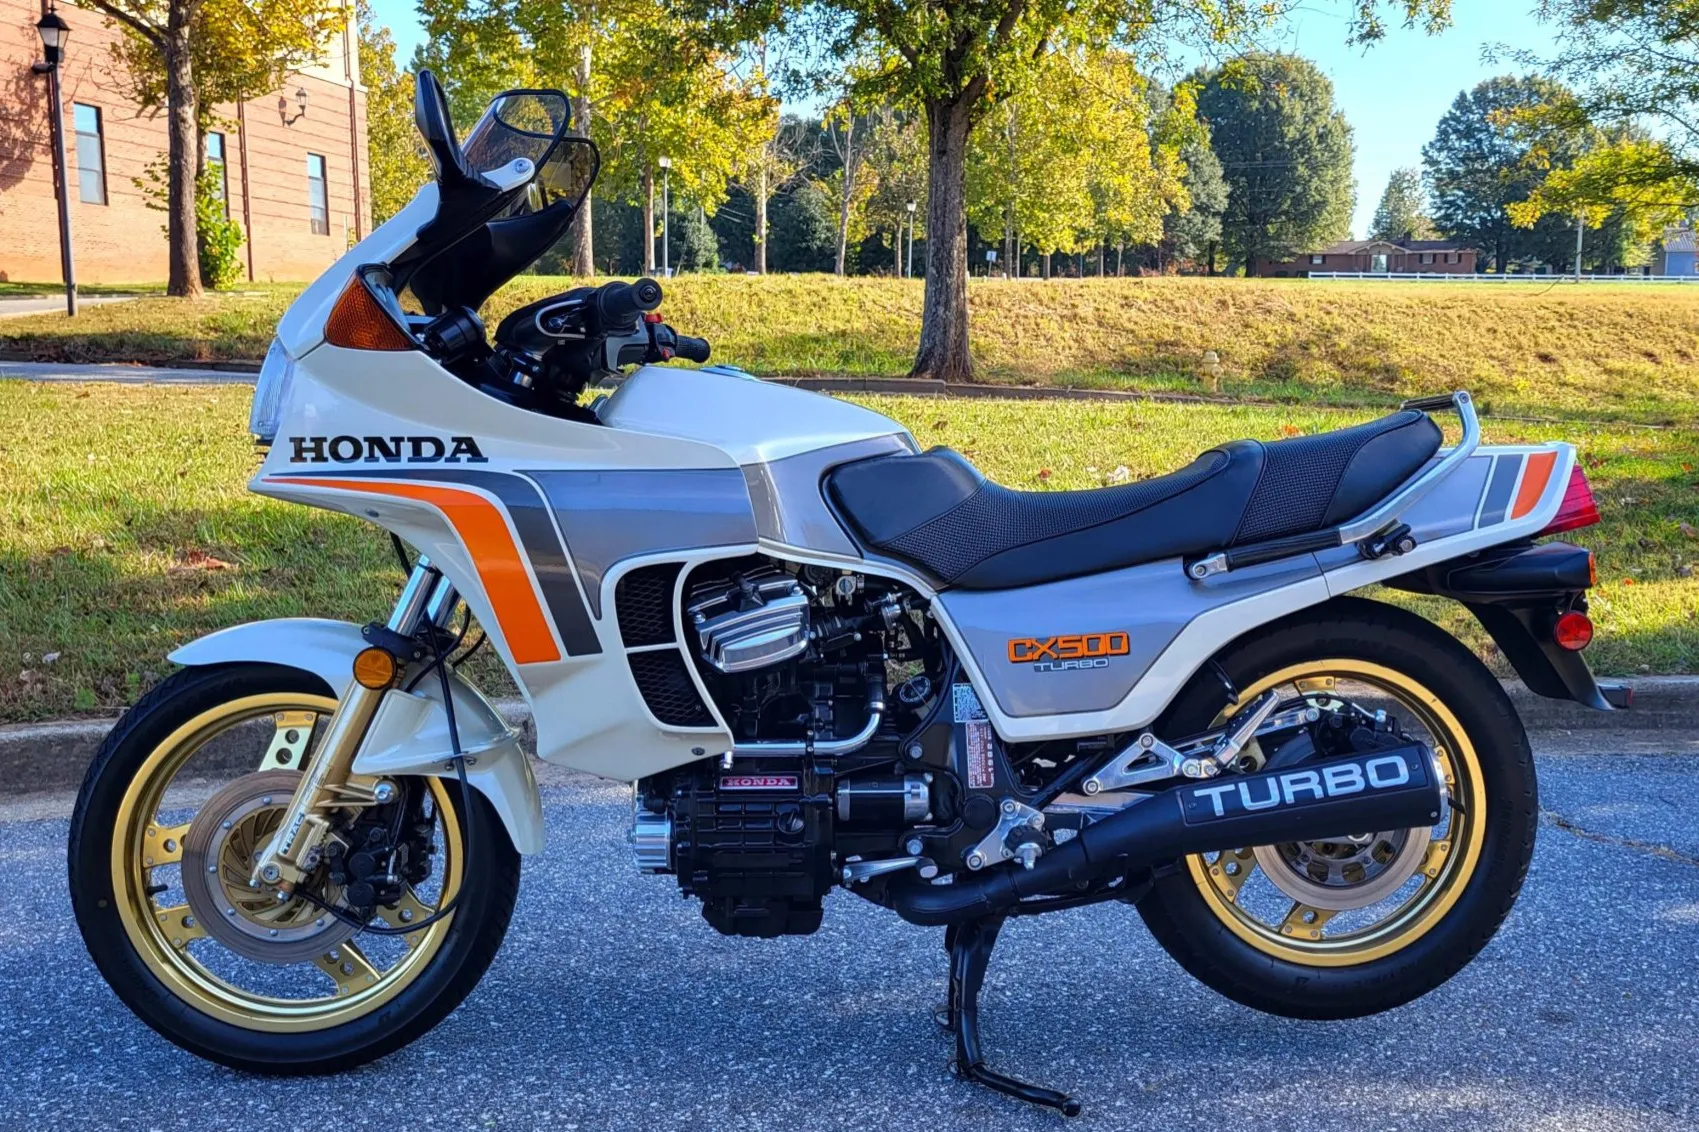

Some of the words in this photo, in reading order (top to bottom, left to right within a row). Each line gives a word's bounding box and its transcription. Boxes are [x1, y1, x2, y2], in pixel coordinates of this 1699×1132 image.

[289, 435, 489, 464] HONDA
[1007, 631, 1130, 664] CX500
[1033, 657, 1110, 672] TURBO
[726, 778, 791, 786] HONDA
[1193, 755, 1410, 817] TURBO
